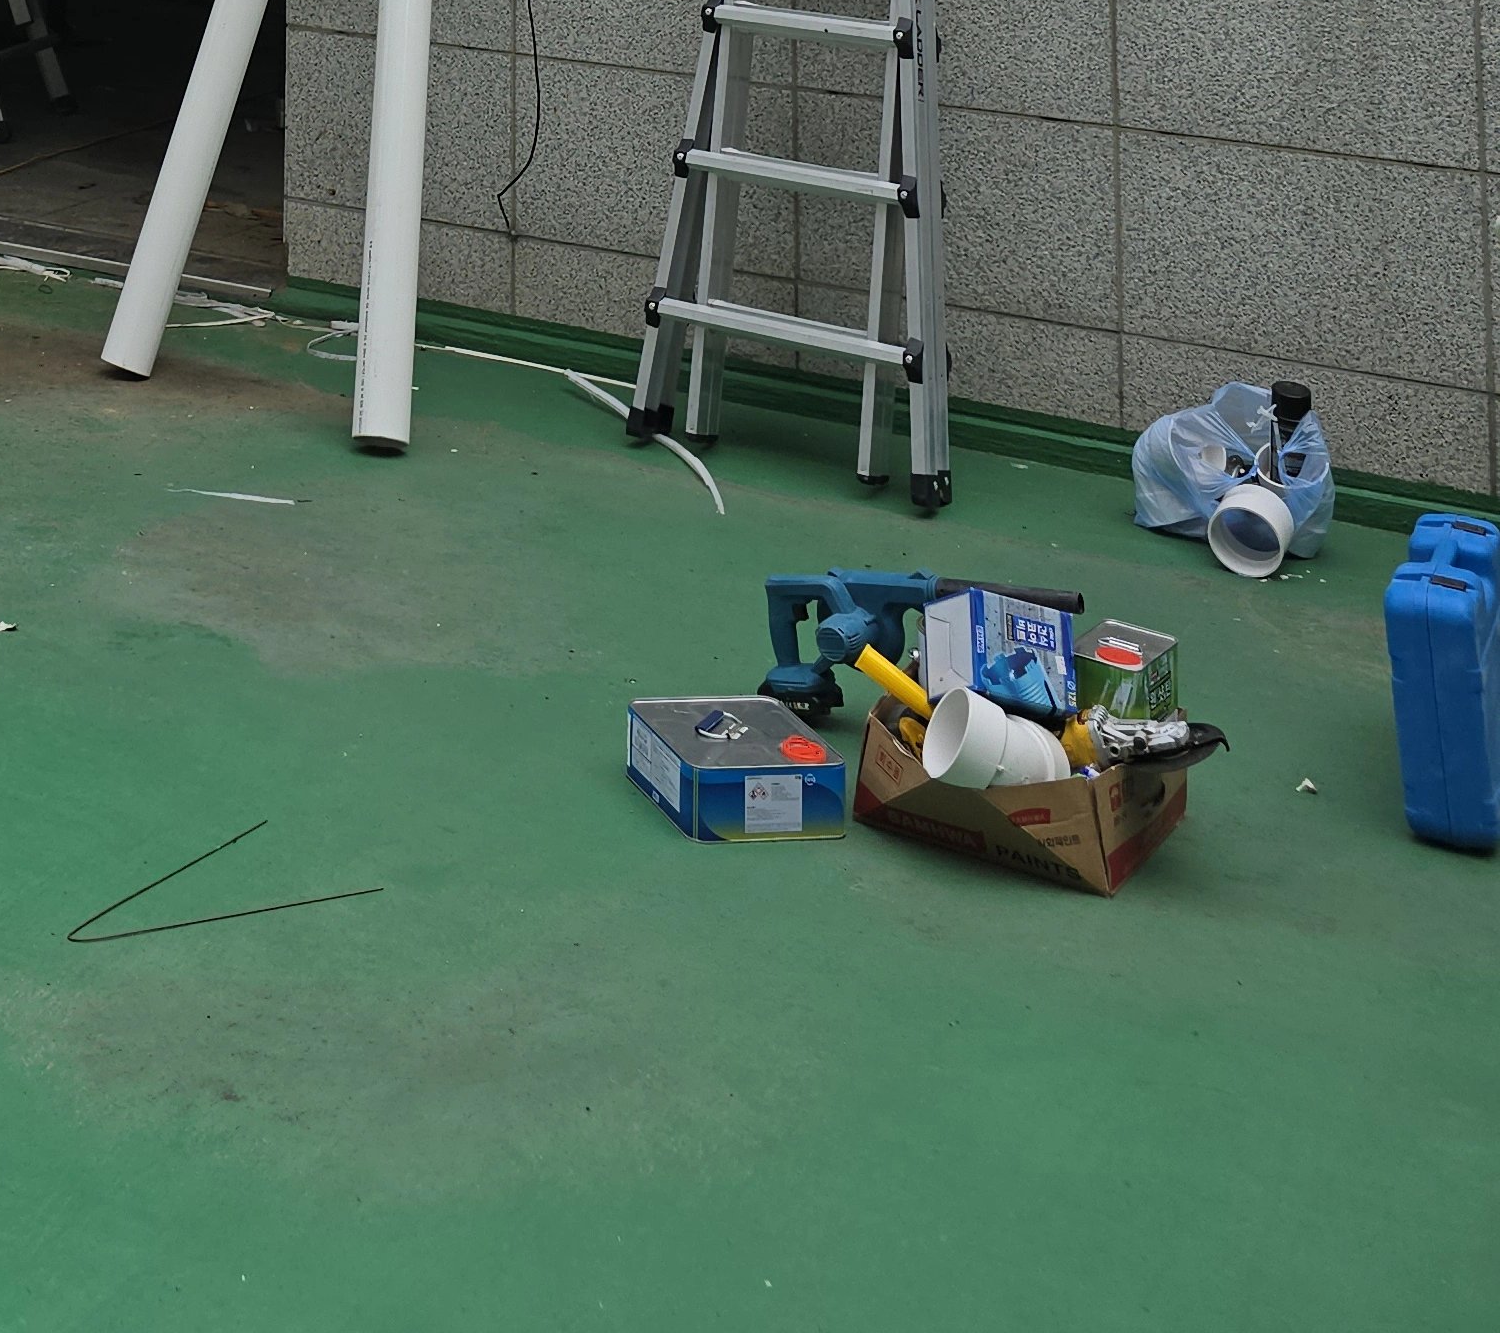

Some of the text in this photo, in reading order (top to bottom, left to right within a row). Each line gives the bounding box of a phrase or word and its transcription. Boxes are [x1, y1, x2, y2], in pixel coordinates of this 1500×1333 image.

[915, 9, 925, 99] LADDER
[1017, 619, 1026, 640] 비트
[1027, 621, 1037, 644] 코아
[1037, 625, 1049, 647] 건식
[995, 844, 1082, 879] PAINTS
